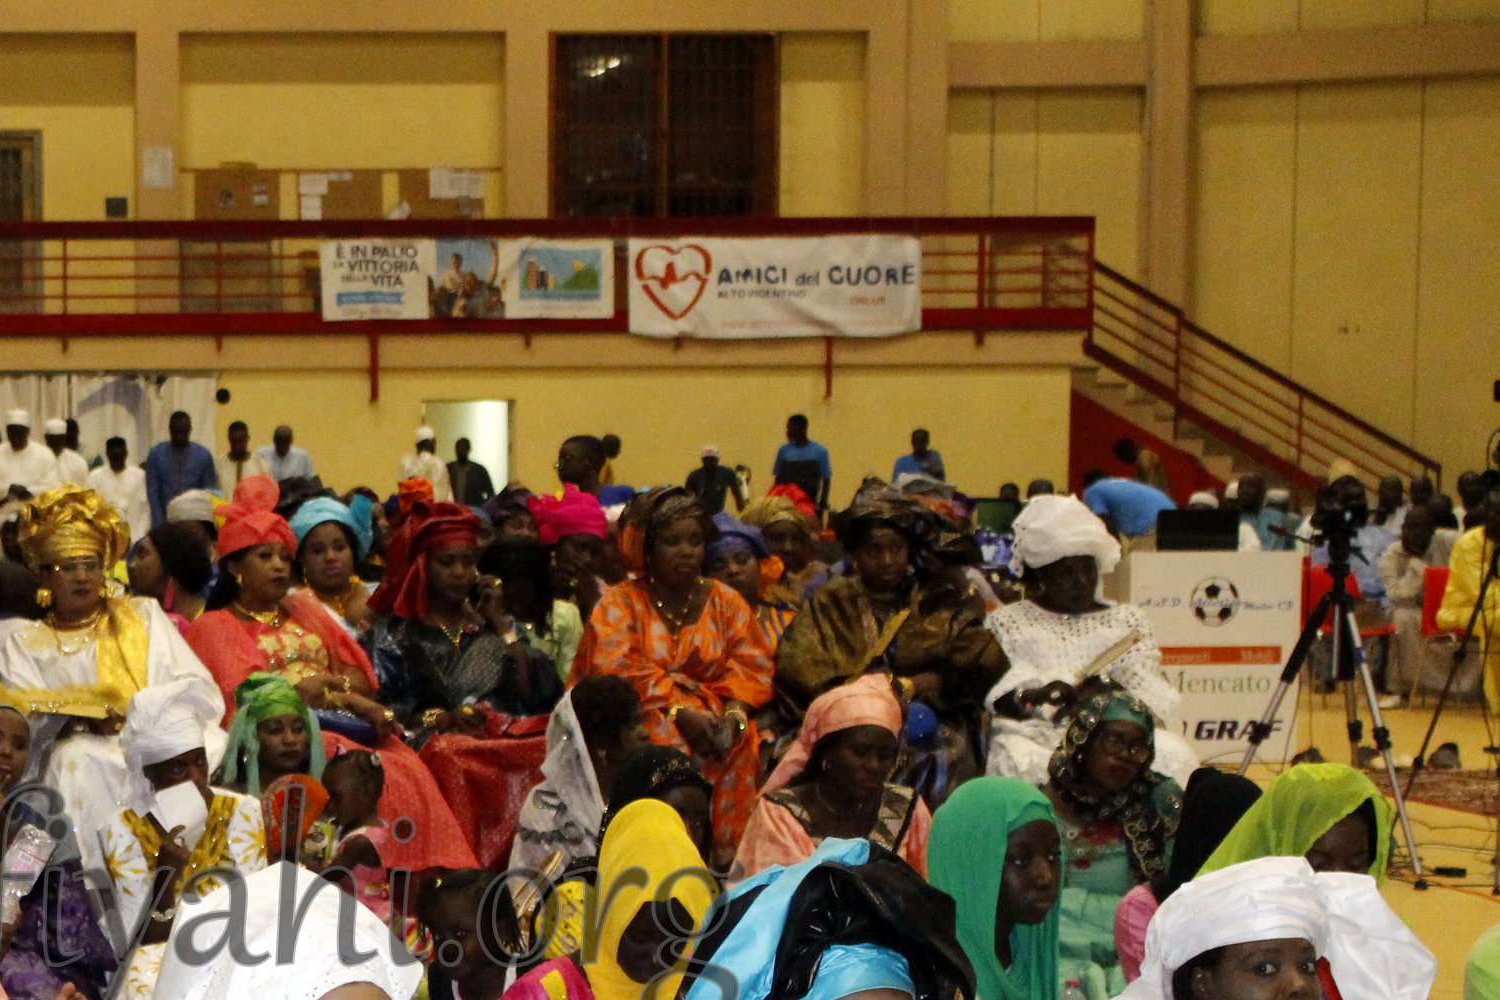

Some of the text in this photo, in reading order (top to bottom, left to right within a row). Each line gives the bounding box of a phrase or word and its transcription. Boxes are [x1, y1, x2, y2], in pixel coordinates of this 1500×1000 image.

[350, 245, 367, 258] IN
[372, 245, 418, 259] PALIO
[348, 260, 420, 274] VITTORIA
[372, 274, 404, 288] VITA
[717, 265, 916, 286] AMICI del CUORE
[1160, 671, 1272, 694] Mencato
